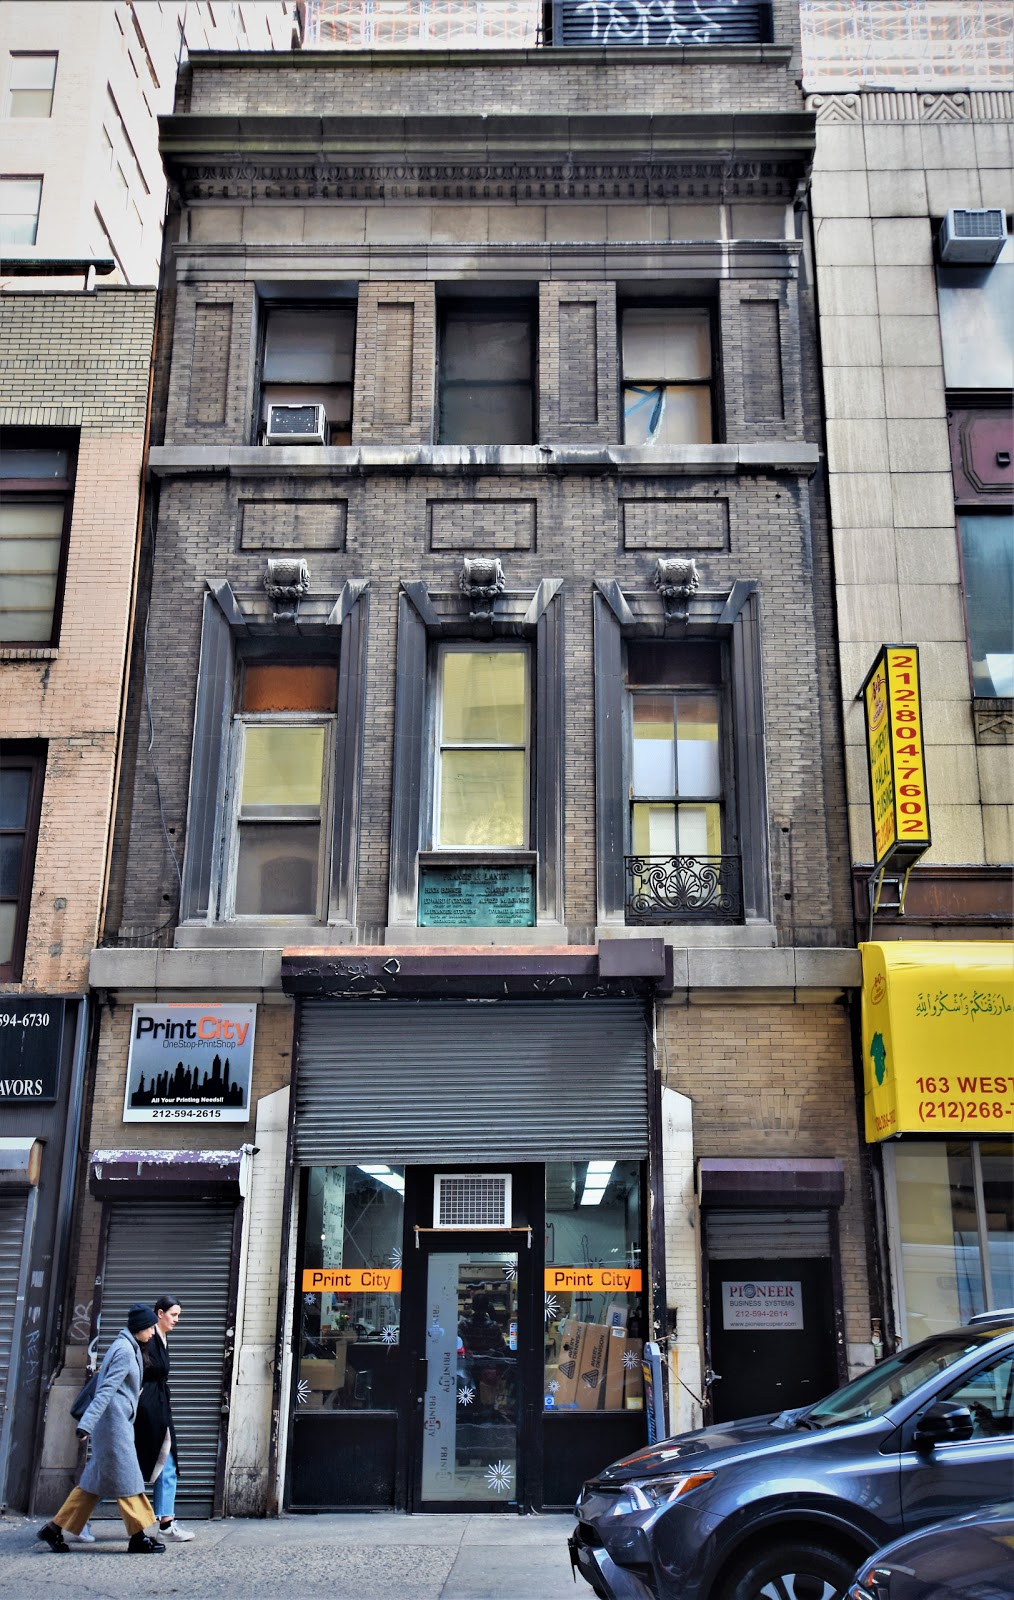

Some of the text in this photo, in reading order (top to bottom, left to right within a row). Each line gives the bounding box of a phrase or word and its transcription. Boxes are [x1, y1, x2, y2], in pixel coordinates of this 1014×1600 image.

[916, 1077, 950, 1093] 163
[152, 1110, 221, 1118] 212-594-2615
[312, 1272, 390, 1290] Print City
[555, 1272, 631, 1289] Print City
[729, 1283, 795, 1298] PIONEER
